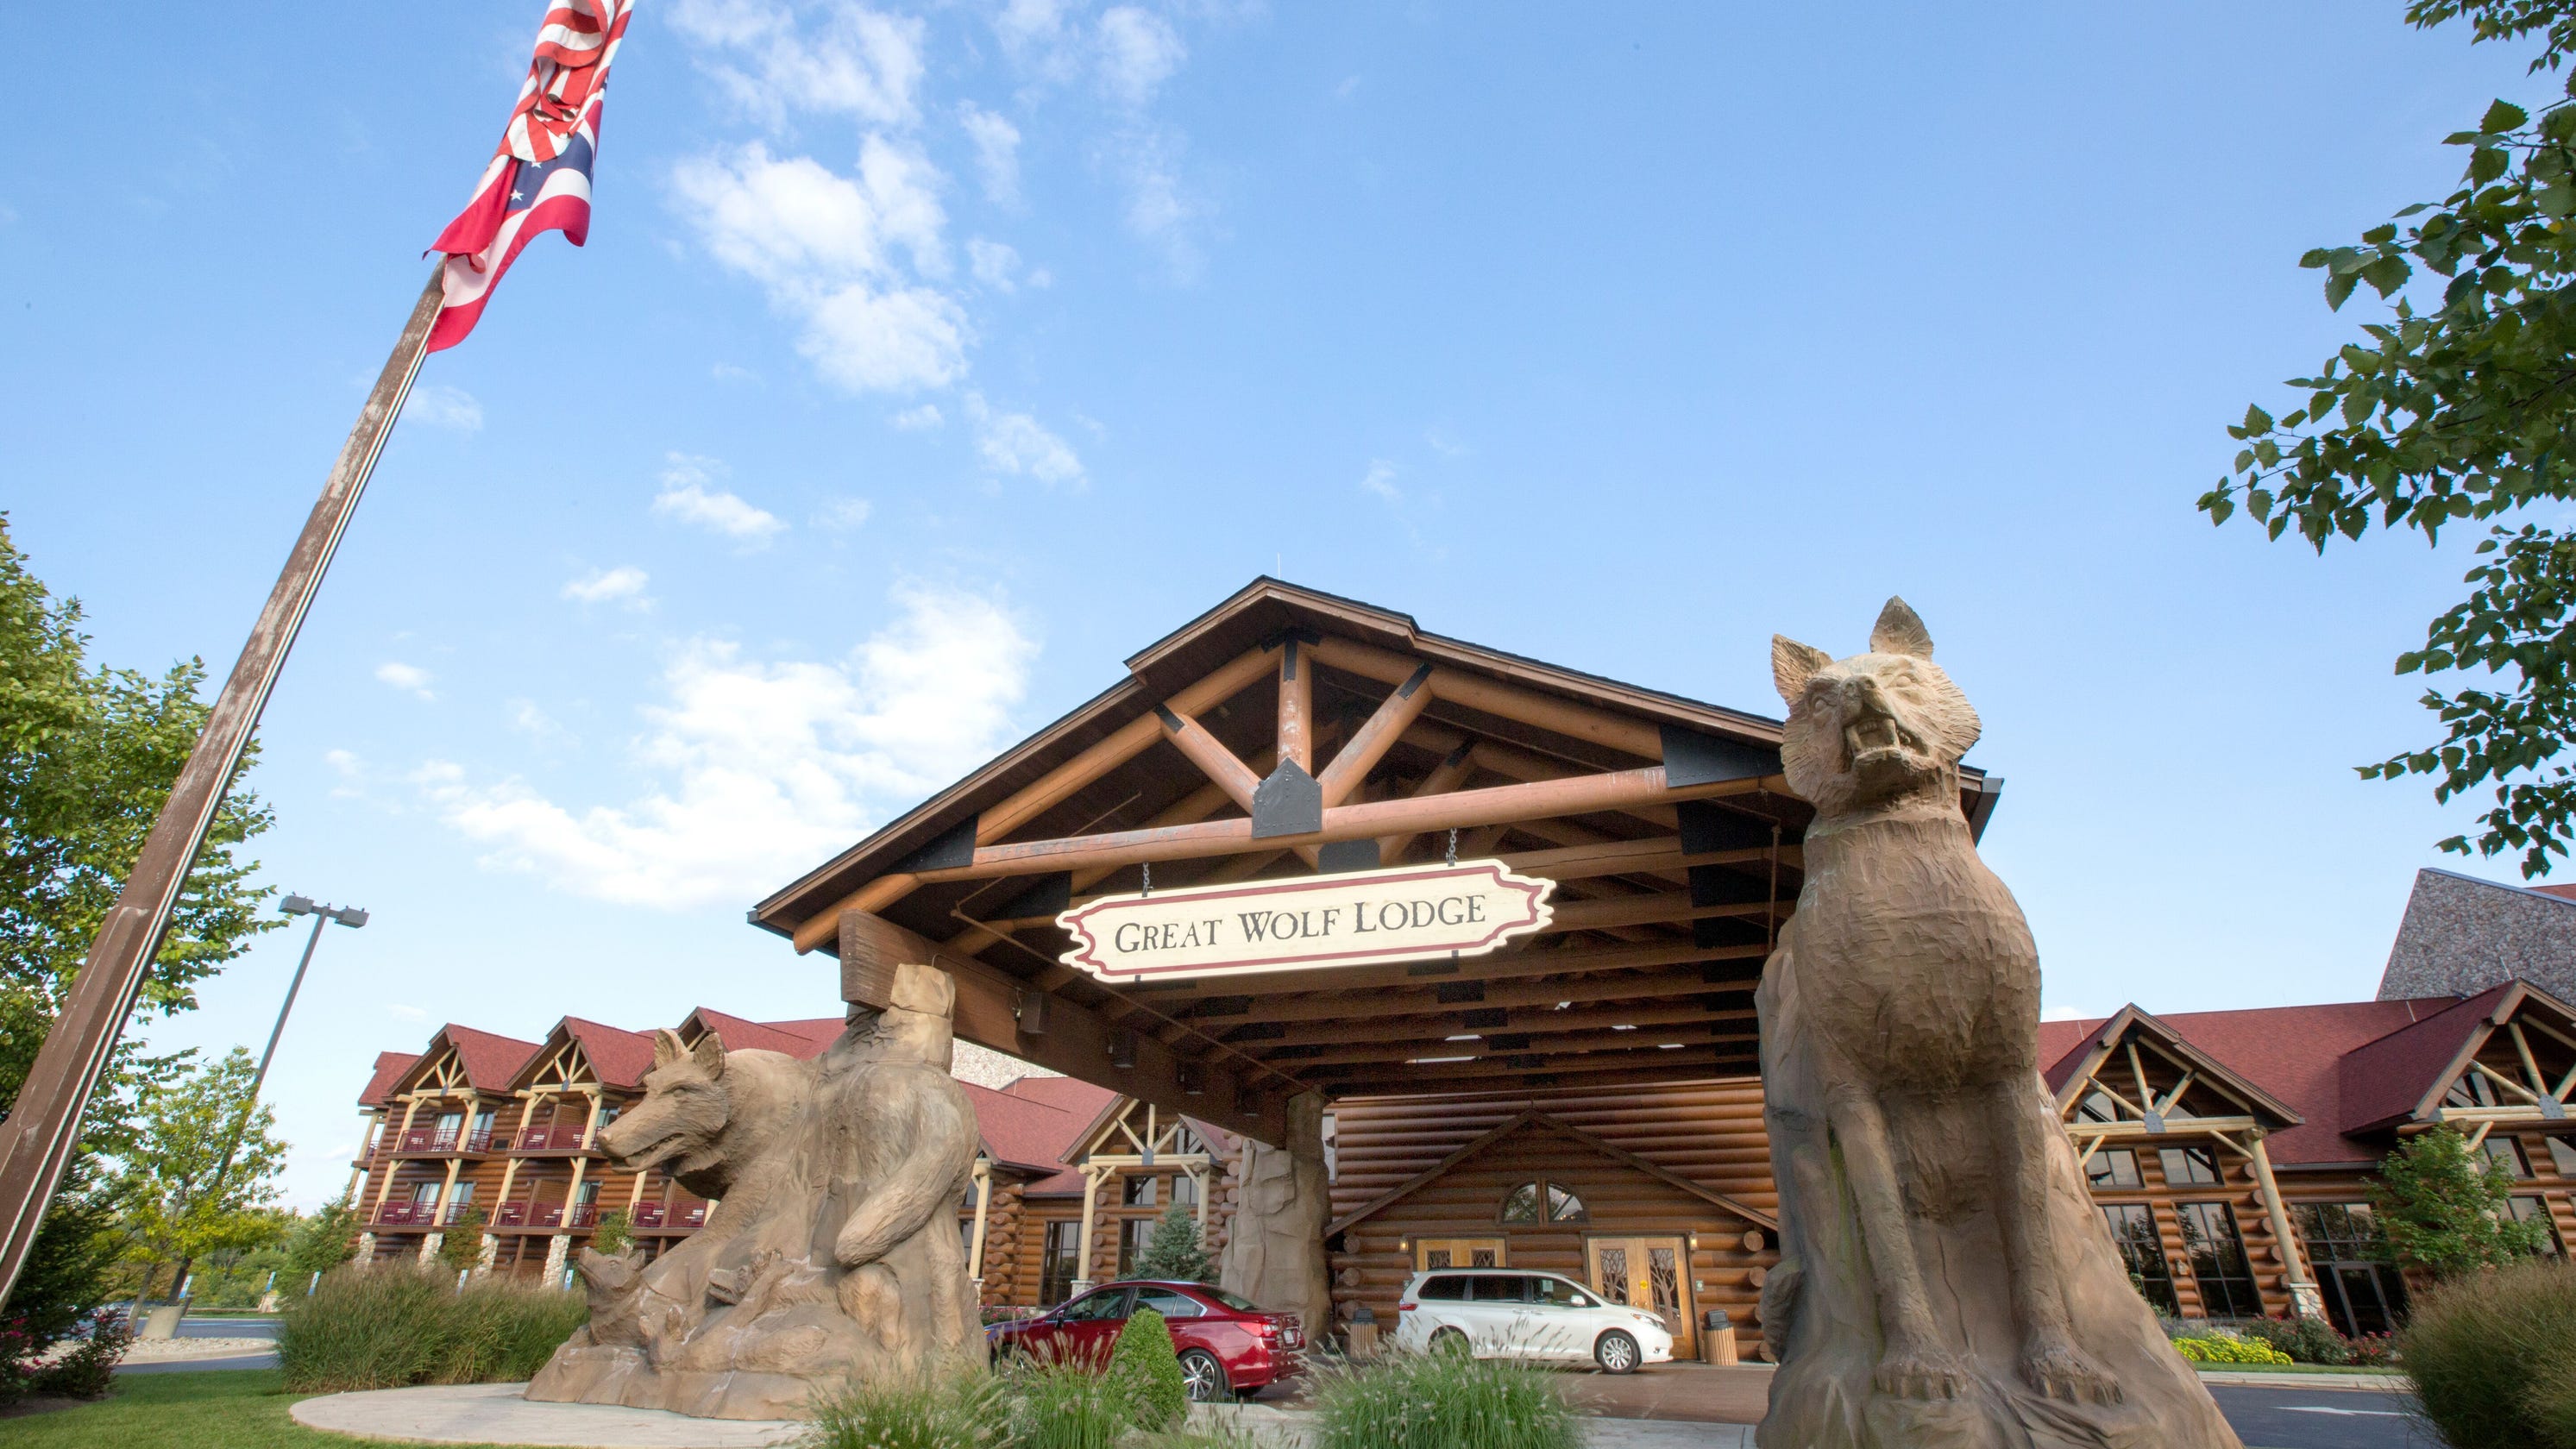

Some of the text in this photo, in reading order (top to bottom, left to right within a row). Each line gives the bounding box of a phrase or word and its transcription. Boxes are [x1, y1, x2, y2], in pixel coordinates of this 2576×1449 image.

[1115, 894, 1486, 953] GREAT WOLF LODGE
